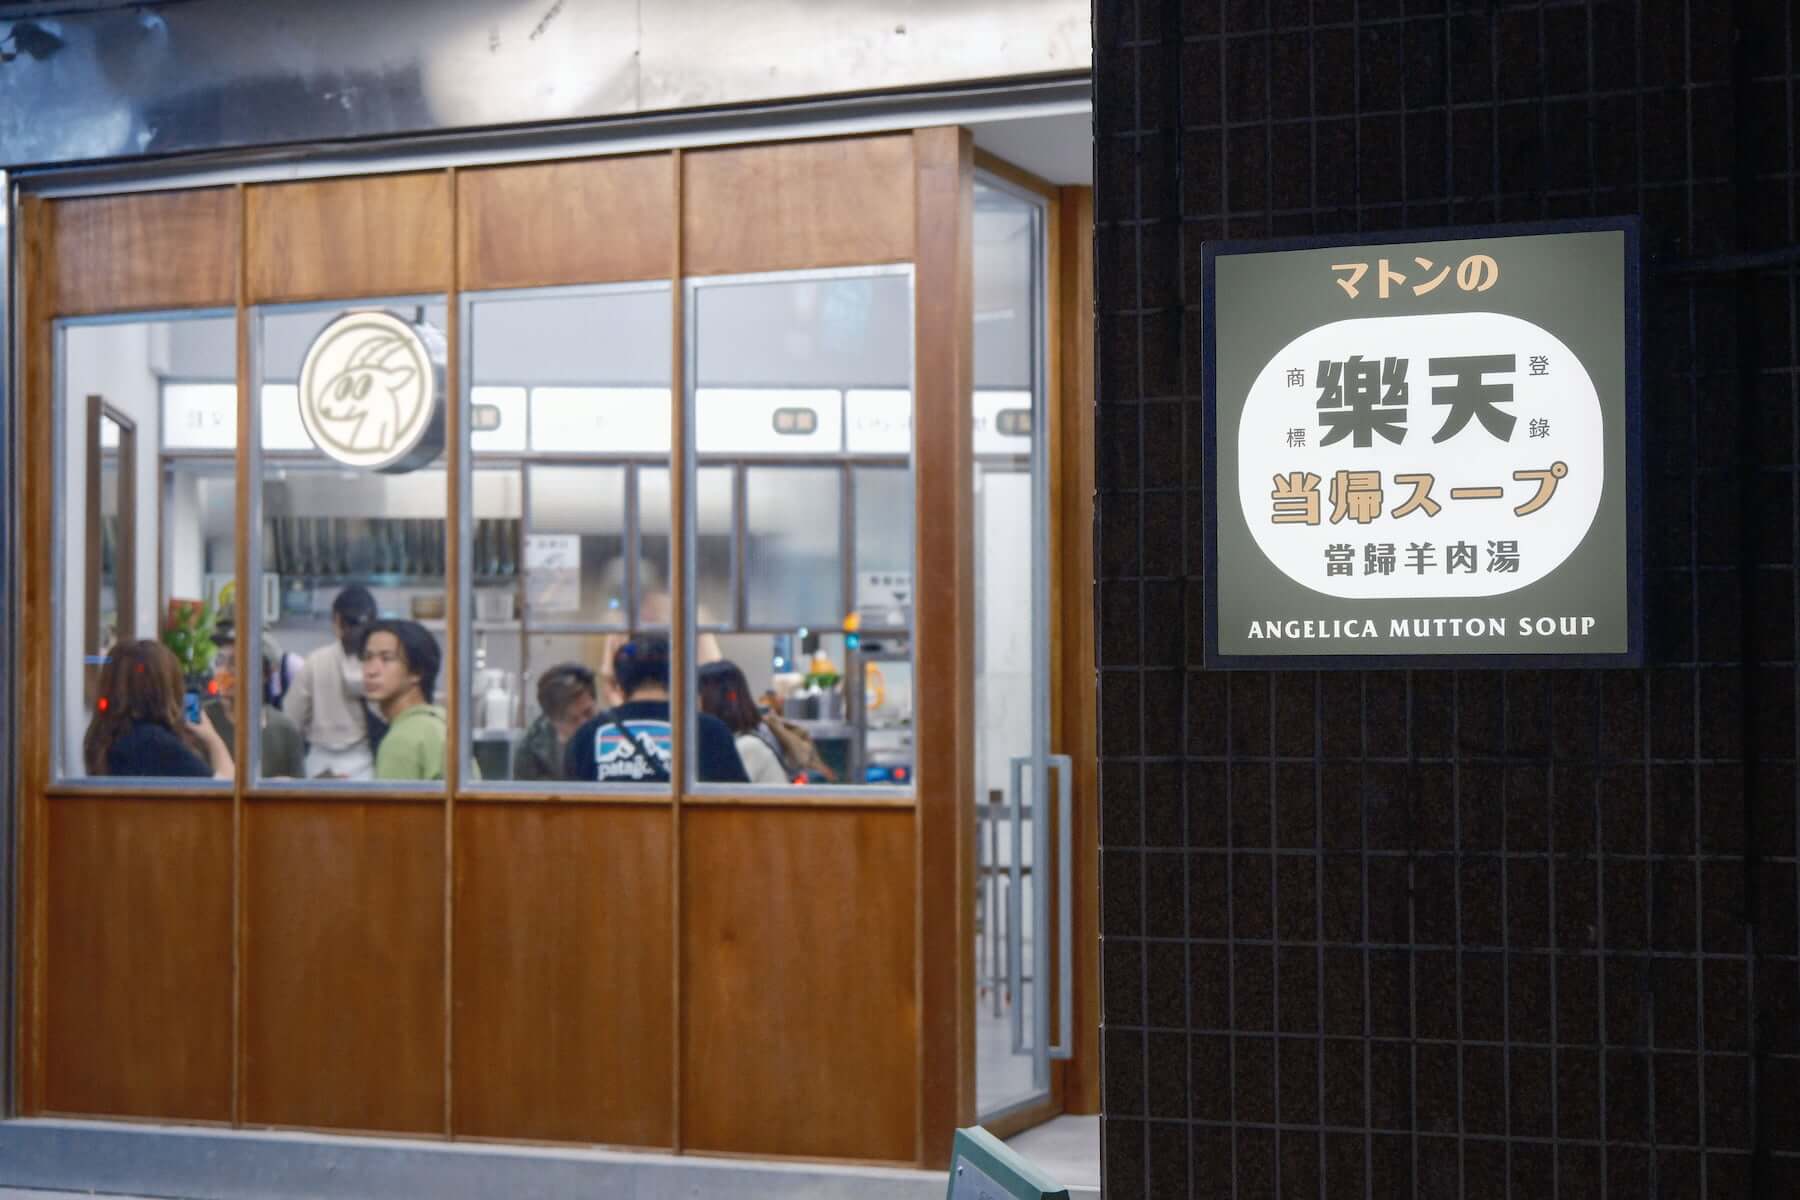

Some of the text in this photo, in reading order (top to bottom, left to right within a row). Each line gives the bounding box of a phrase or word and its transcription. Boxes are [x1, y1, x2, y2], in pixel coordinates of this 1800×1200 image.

[1331, 254, 1499, 299] マトンの
[1315, 353, 1518, 449] 樂天
[1271, 461, 1569, 526] 当帰スープ
[1324, 540, 1521, 577] 當歸羊肉湯
[1248, 616, 1596, 639] ANGELICA MUTTON SOUP
